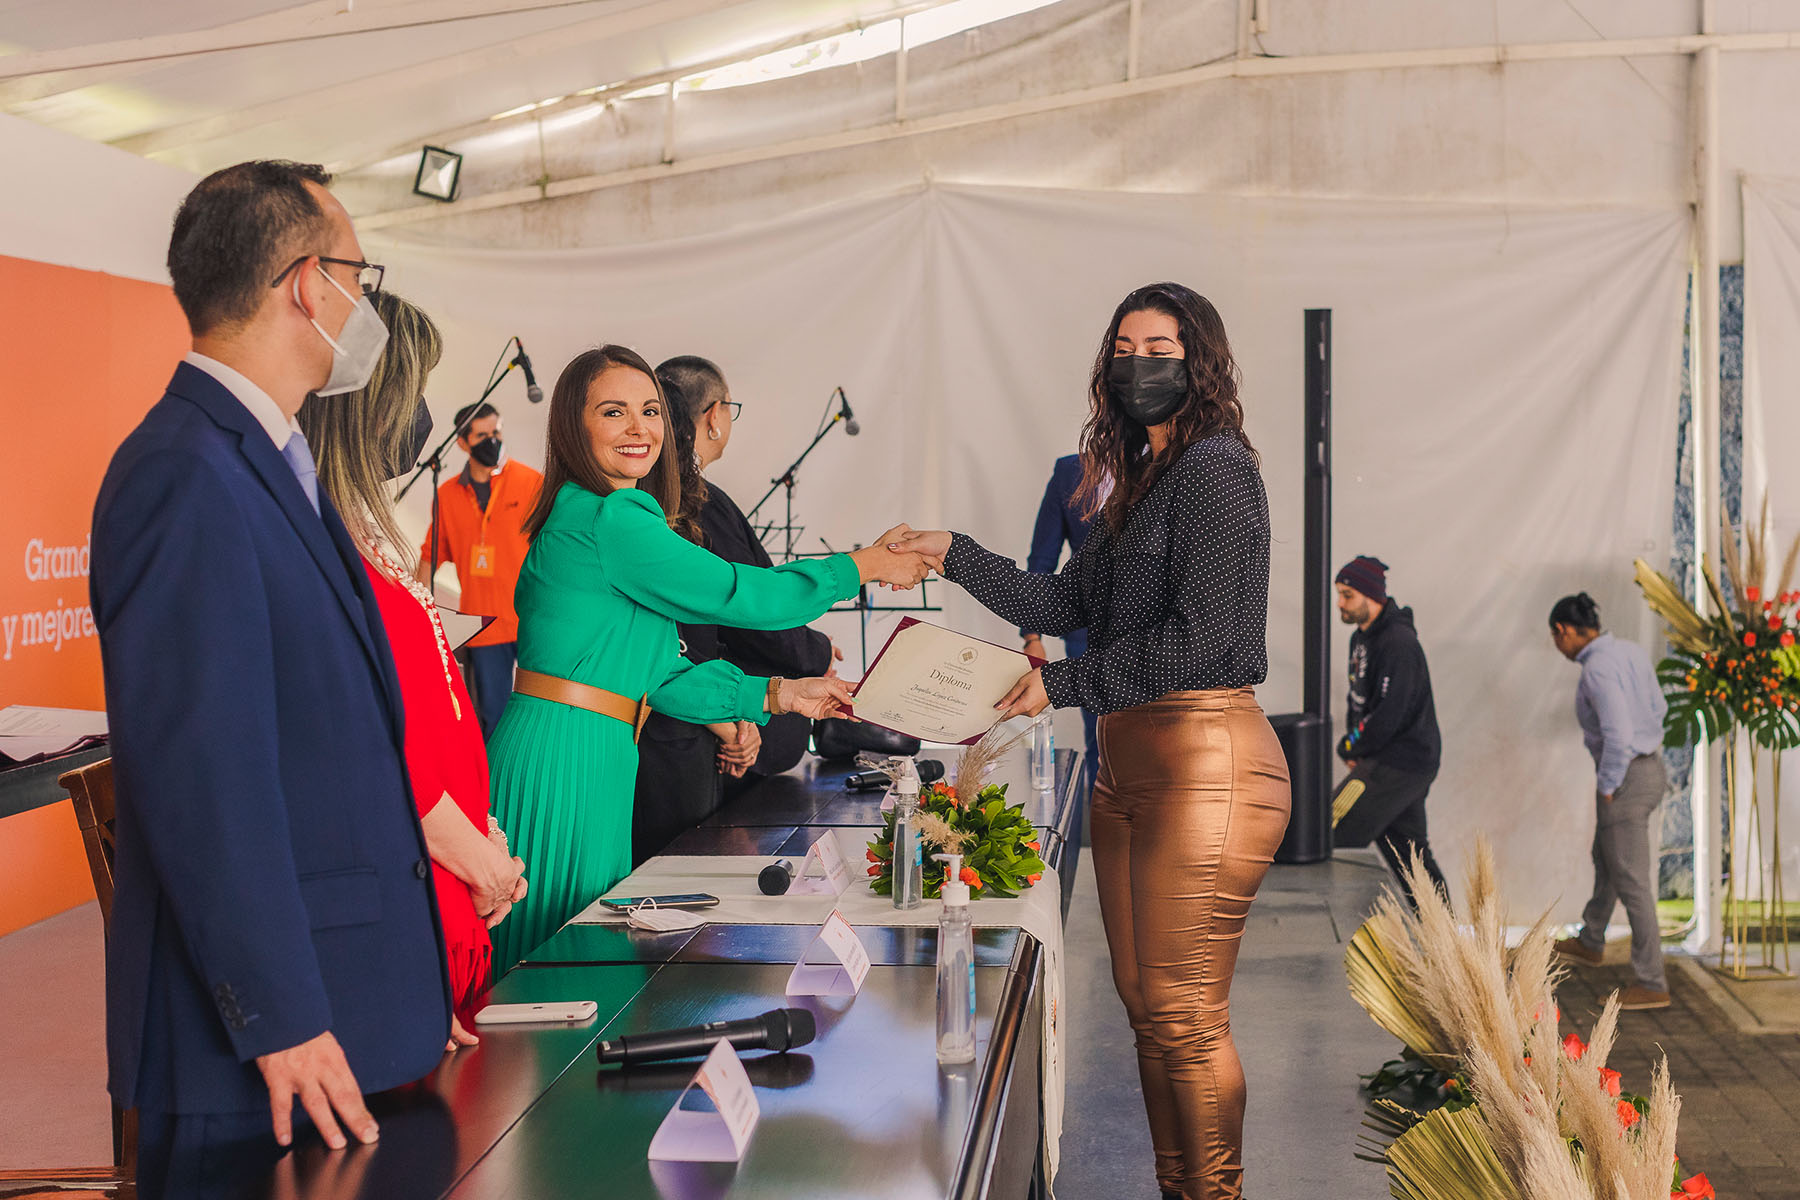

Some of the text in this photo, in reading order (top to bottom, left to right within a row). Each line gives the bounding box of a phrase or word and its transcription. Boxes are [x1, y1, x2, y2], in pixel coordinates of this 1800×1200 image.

[2, 598, 99, 661] y mejore
[929, 669, 973, 691] Diploma
